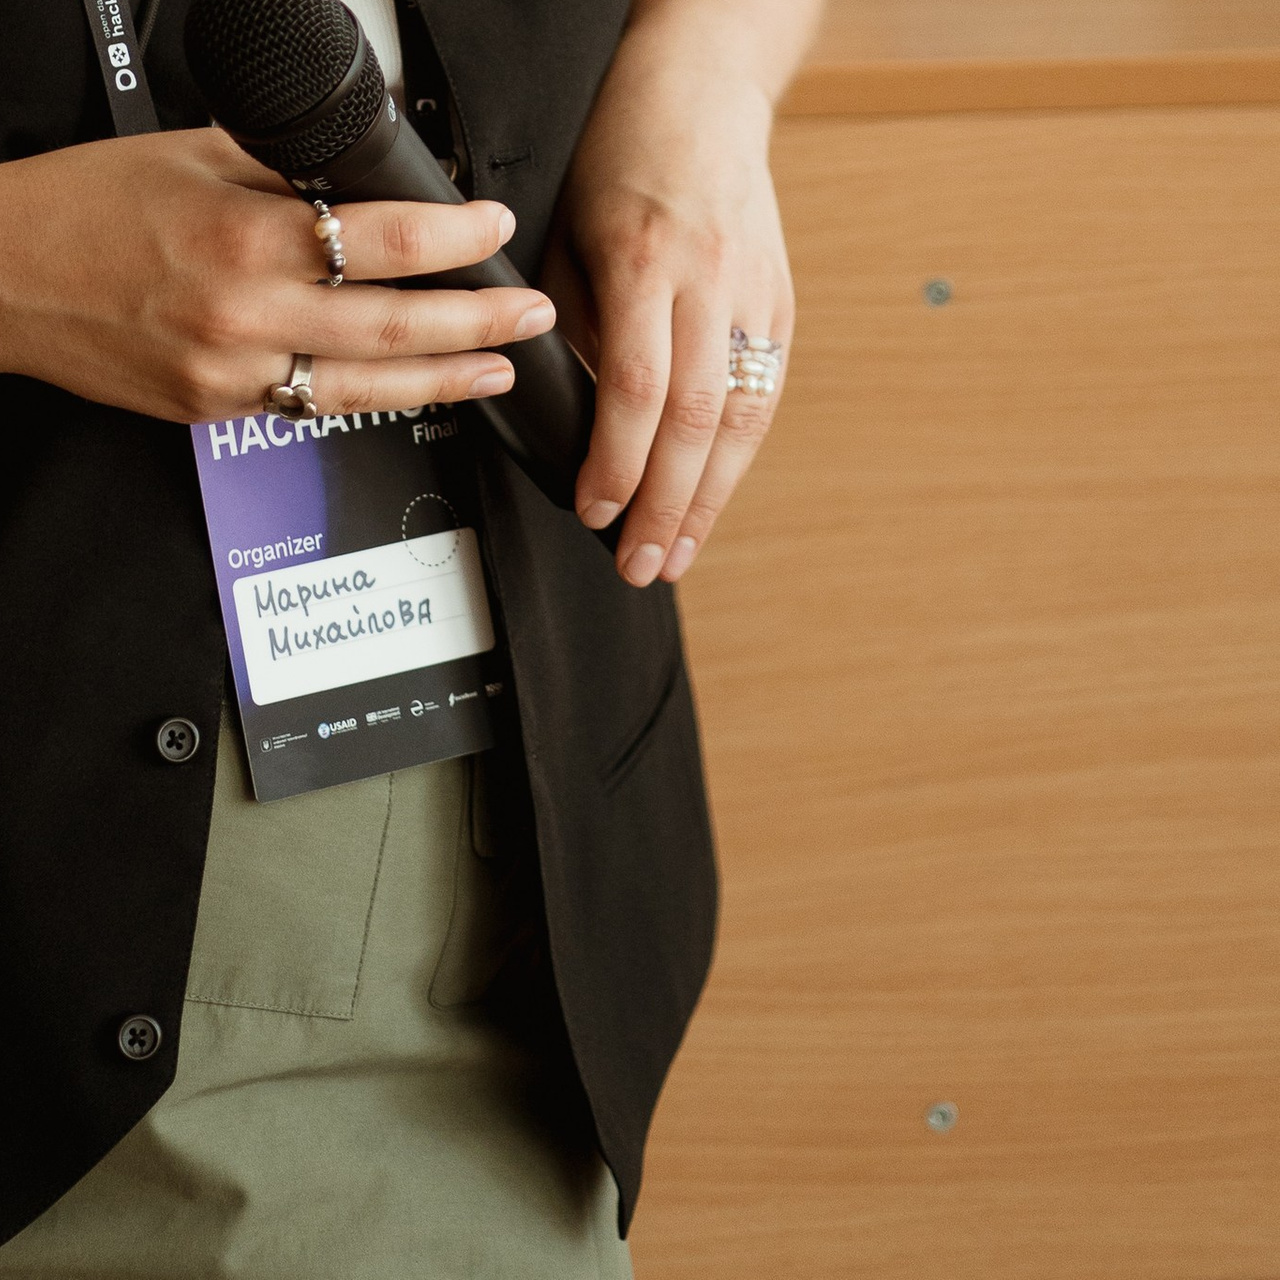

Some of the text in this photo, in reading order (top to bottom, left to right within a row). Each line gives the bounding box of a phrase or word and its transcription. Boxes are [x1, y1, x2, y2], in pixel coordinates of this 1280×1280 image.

[100, 13, 111, 39] open
[412, 418, 459, 444] Final
[227, 532, 324, 569] Organizer
[253, 570, 377, 619] Марина
[329, 717, 358, 732] USAID
